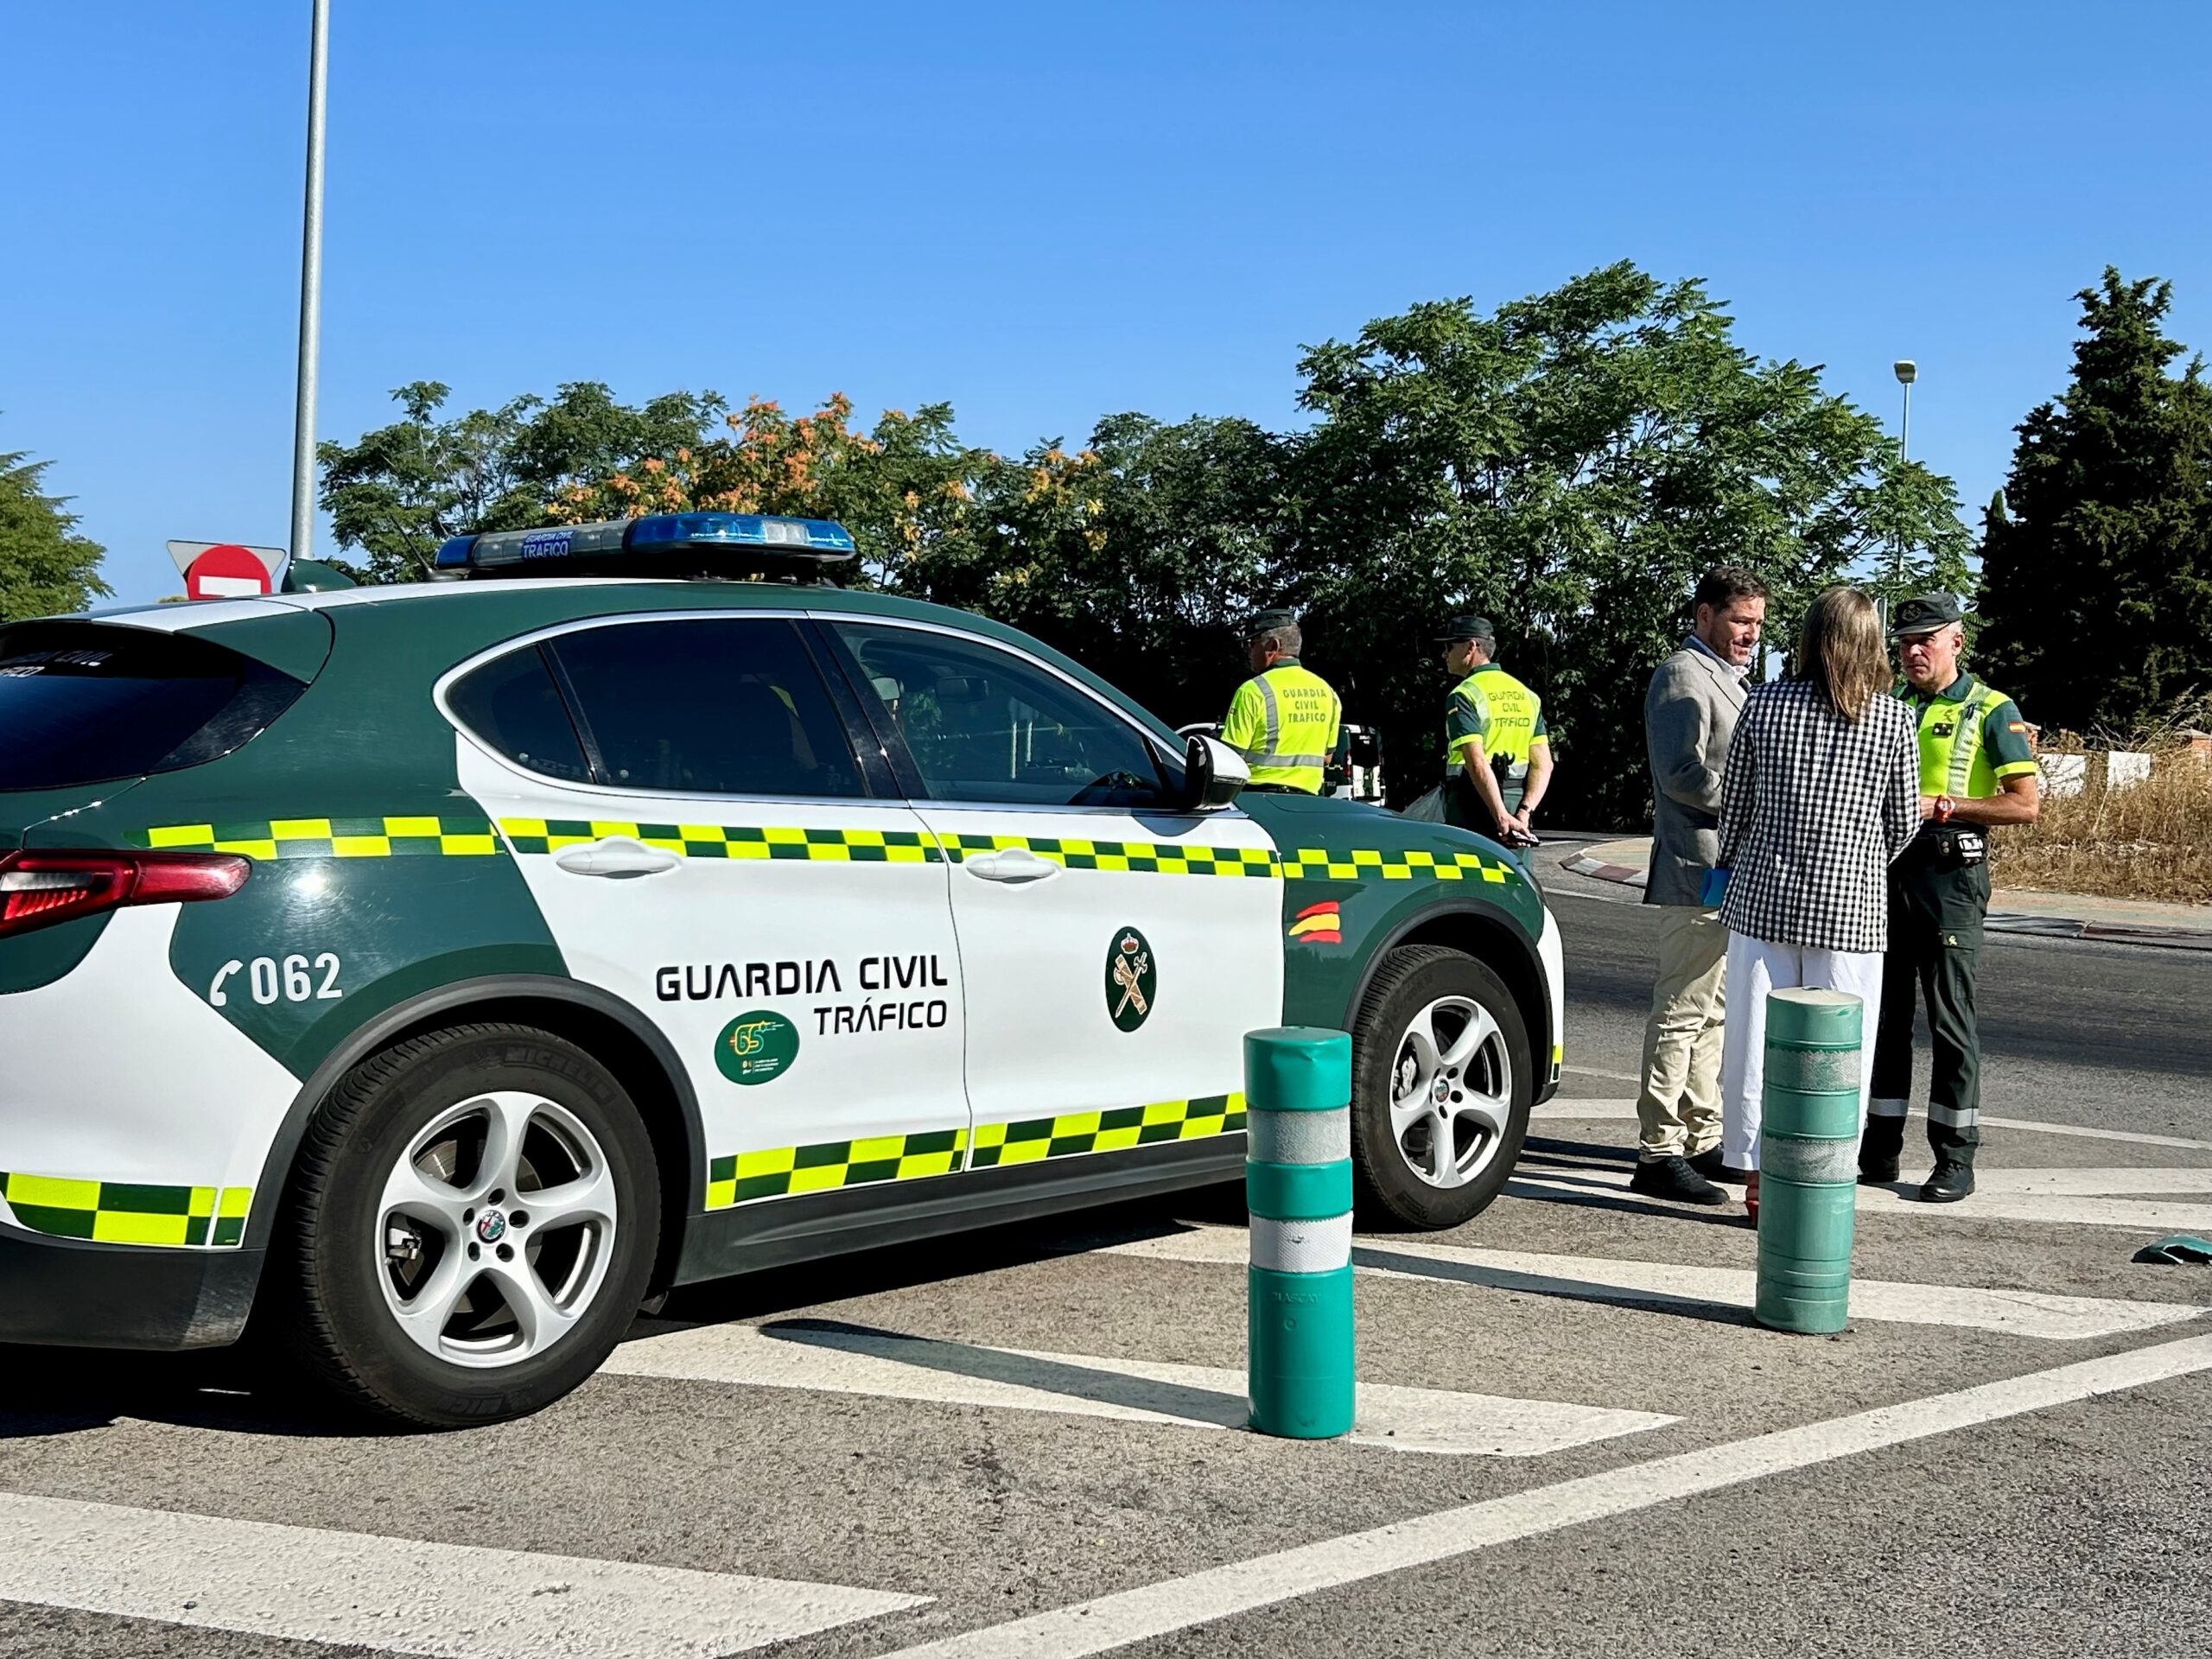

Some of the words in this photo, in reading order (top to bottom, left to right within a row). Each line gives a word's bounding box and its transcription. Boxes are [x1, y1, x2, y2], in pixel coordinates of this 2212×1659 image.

[523, 540, 569, 560] TRAFICO
[1282, 689, 1327, 698] GUARDIA
[1294, 700, 1319, 710] CIVIL
[1287, 712, 1326, 724] TRAFICO
[1494, 717, 1530, 728] TRAFICO
[250, 952, 343, 1005] 062
[656, 959, 842, 1001] GUARDIA
[859, 955, 948, 990] CIVIL
[813, 996, 948, 1035] TRÁFICO
